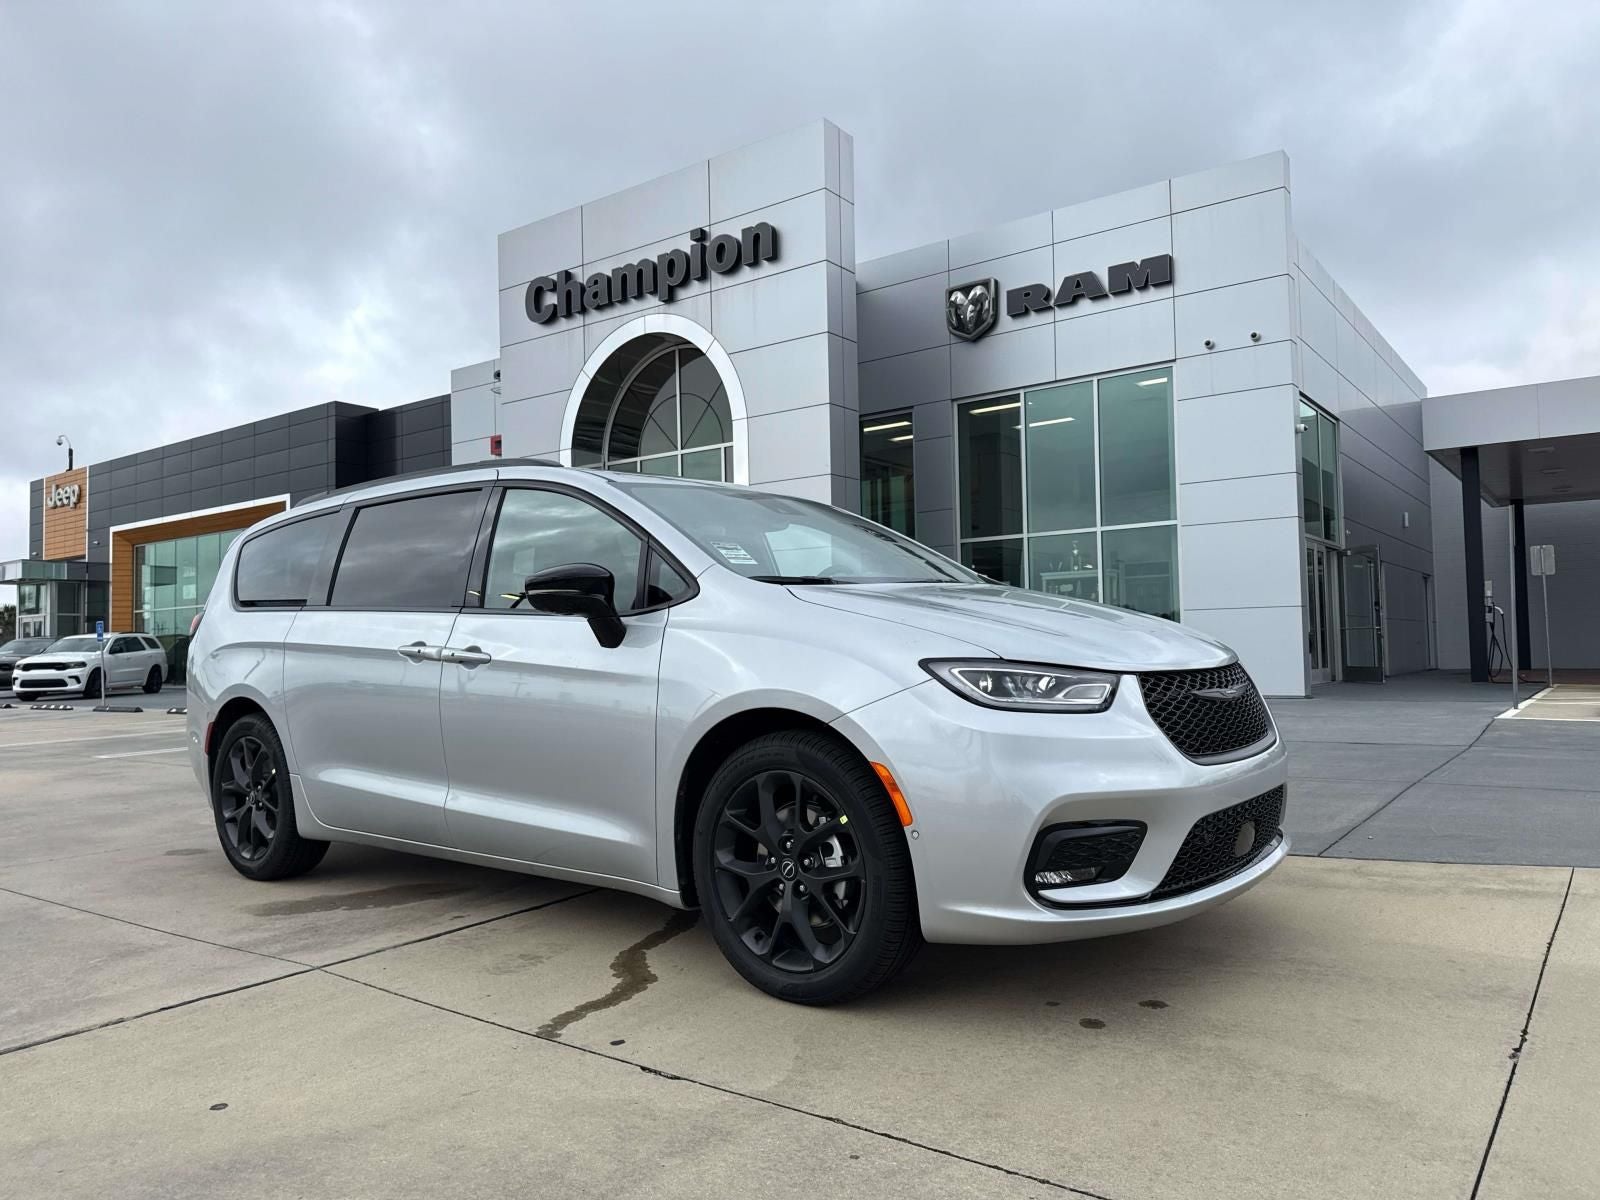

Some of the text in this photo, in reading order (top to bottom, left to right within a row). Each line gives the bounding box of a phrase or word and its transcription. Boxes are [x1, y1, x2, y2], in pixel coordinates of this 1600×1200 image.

[525, 222, 778, 324] Champion
[1007, 254, 1173, 316] RAM
[47, 484, 80, 508] Jeep
